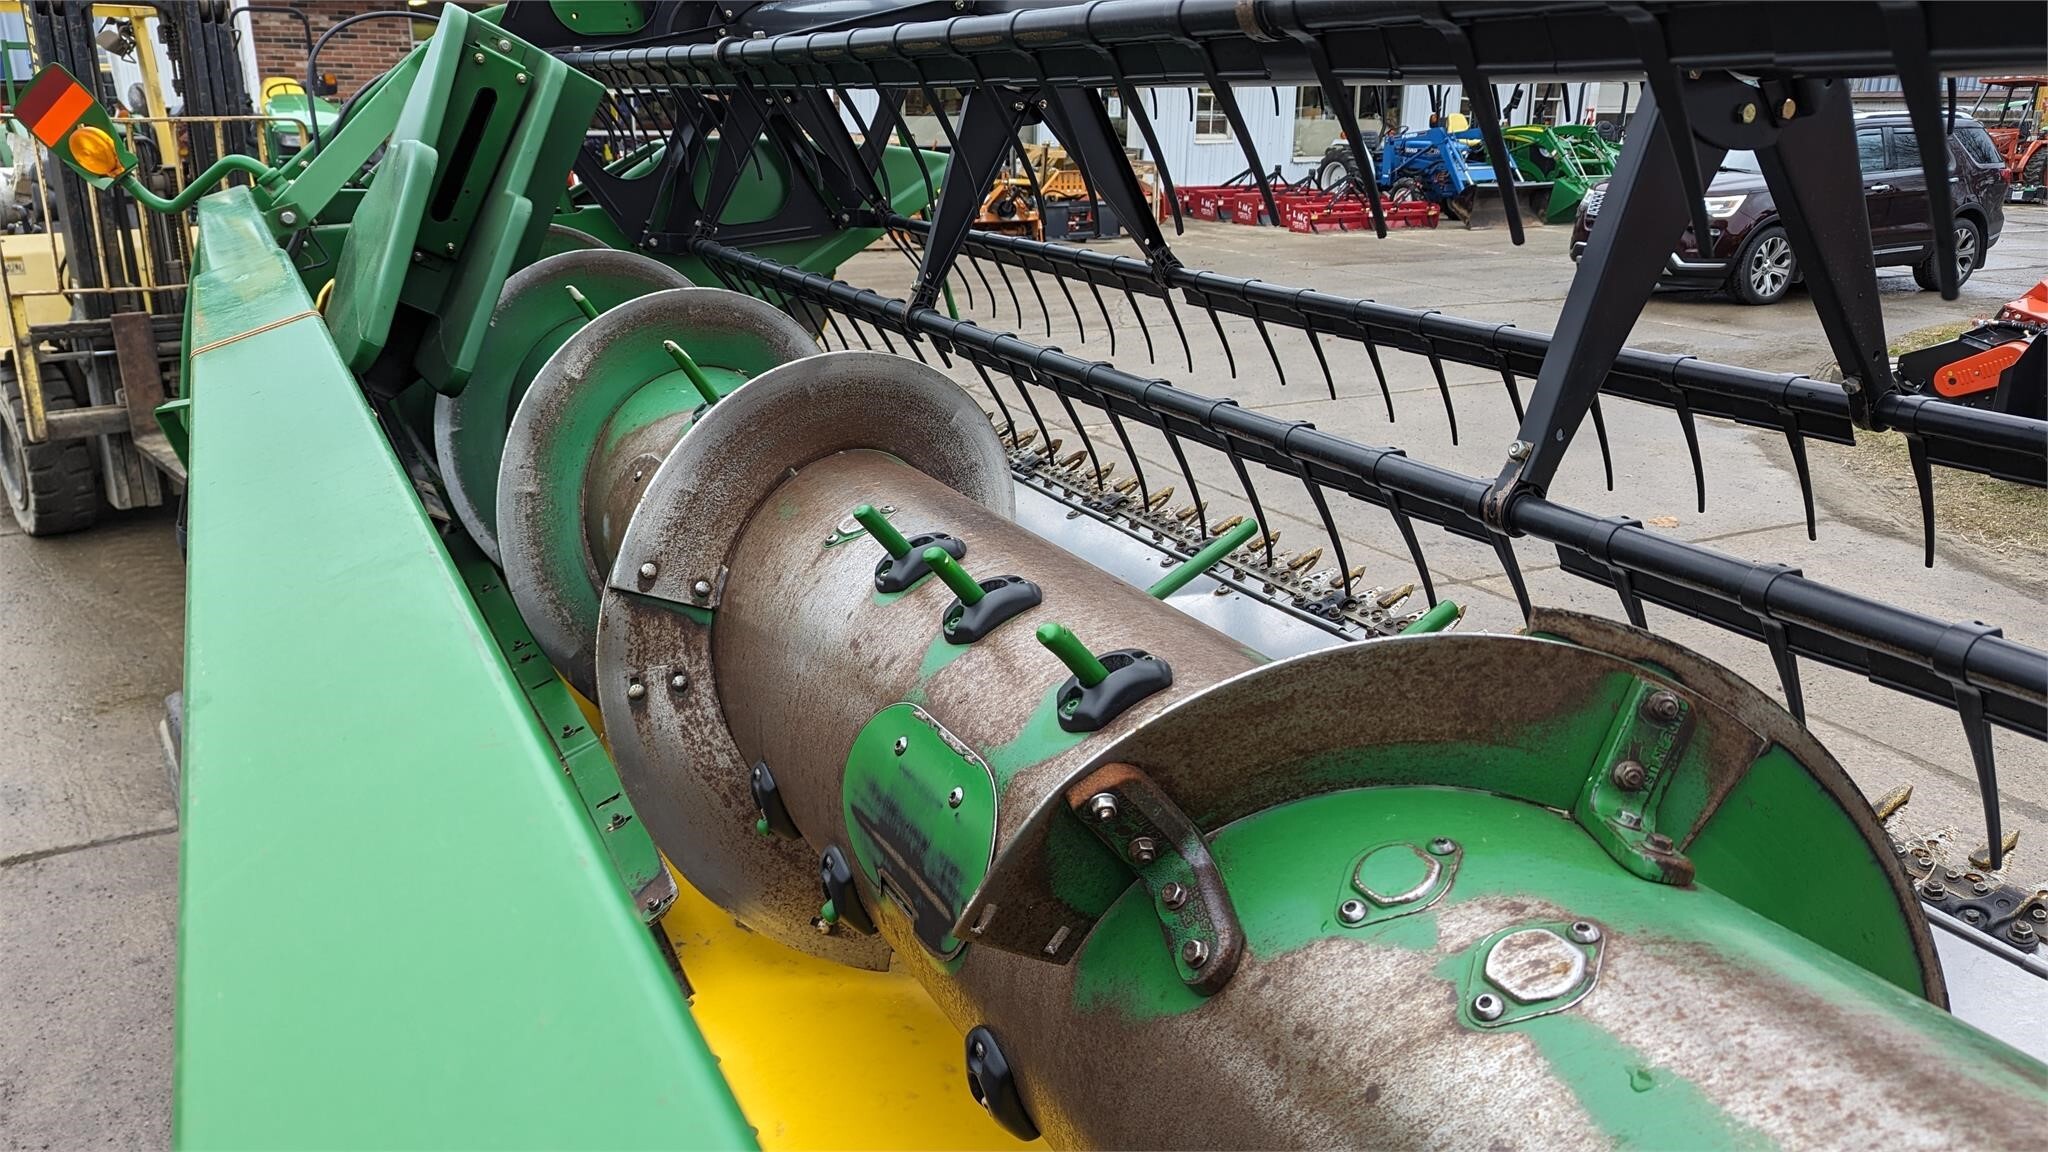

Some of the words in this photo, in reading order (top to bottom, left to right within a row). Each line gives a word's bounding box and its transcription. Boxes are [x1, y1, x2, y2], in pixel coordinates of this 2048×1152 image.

[1201, 198, 1215, 210] LMC
[1238, 201, 1253, 215] LMC
[1293, 210, 1309, 224] LMC
